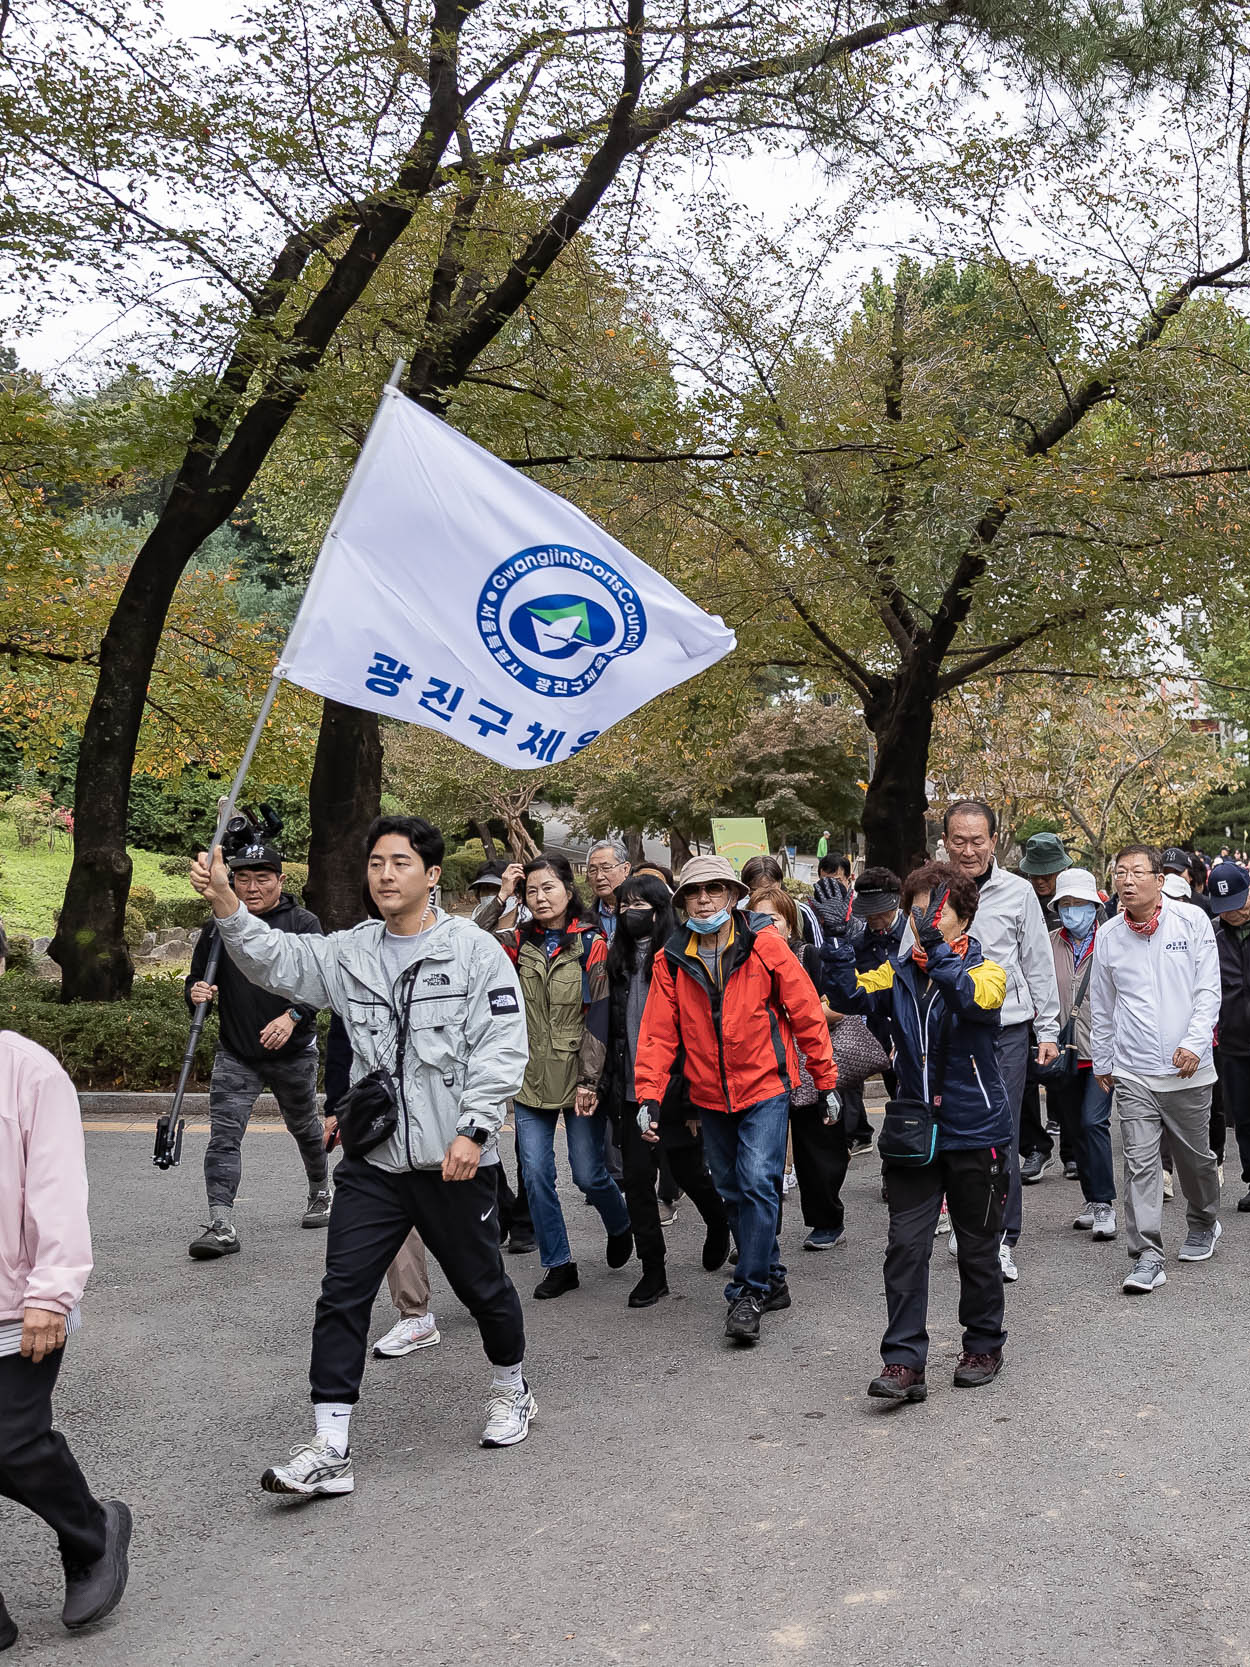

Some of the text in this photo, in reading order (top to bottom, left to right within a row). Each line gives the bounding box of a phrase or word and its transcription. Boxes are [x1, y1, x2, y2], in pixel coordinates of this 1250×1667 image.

[492, 548, 640, 649] GwangjinSportsCouncil
[481, 603, 620, 694] 서울특별시 광진구체육
